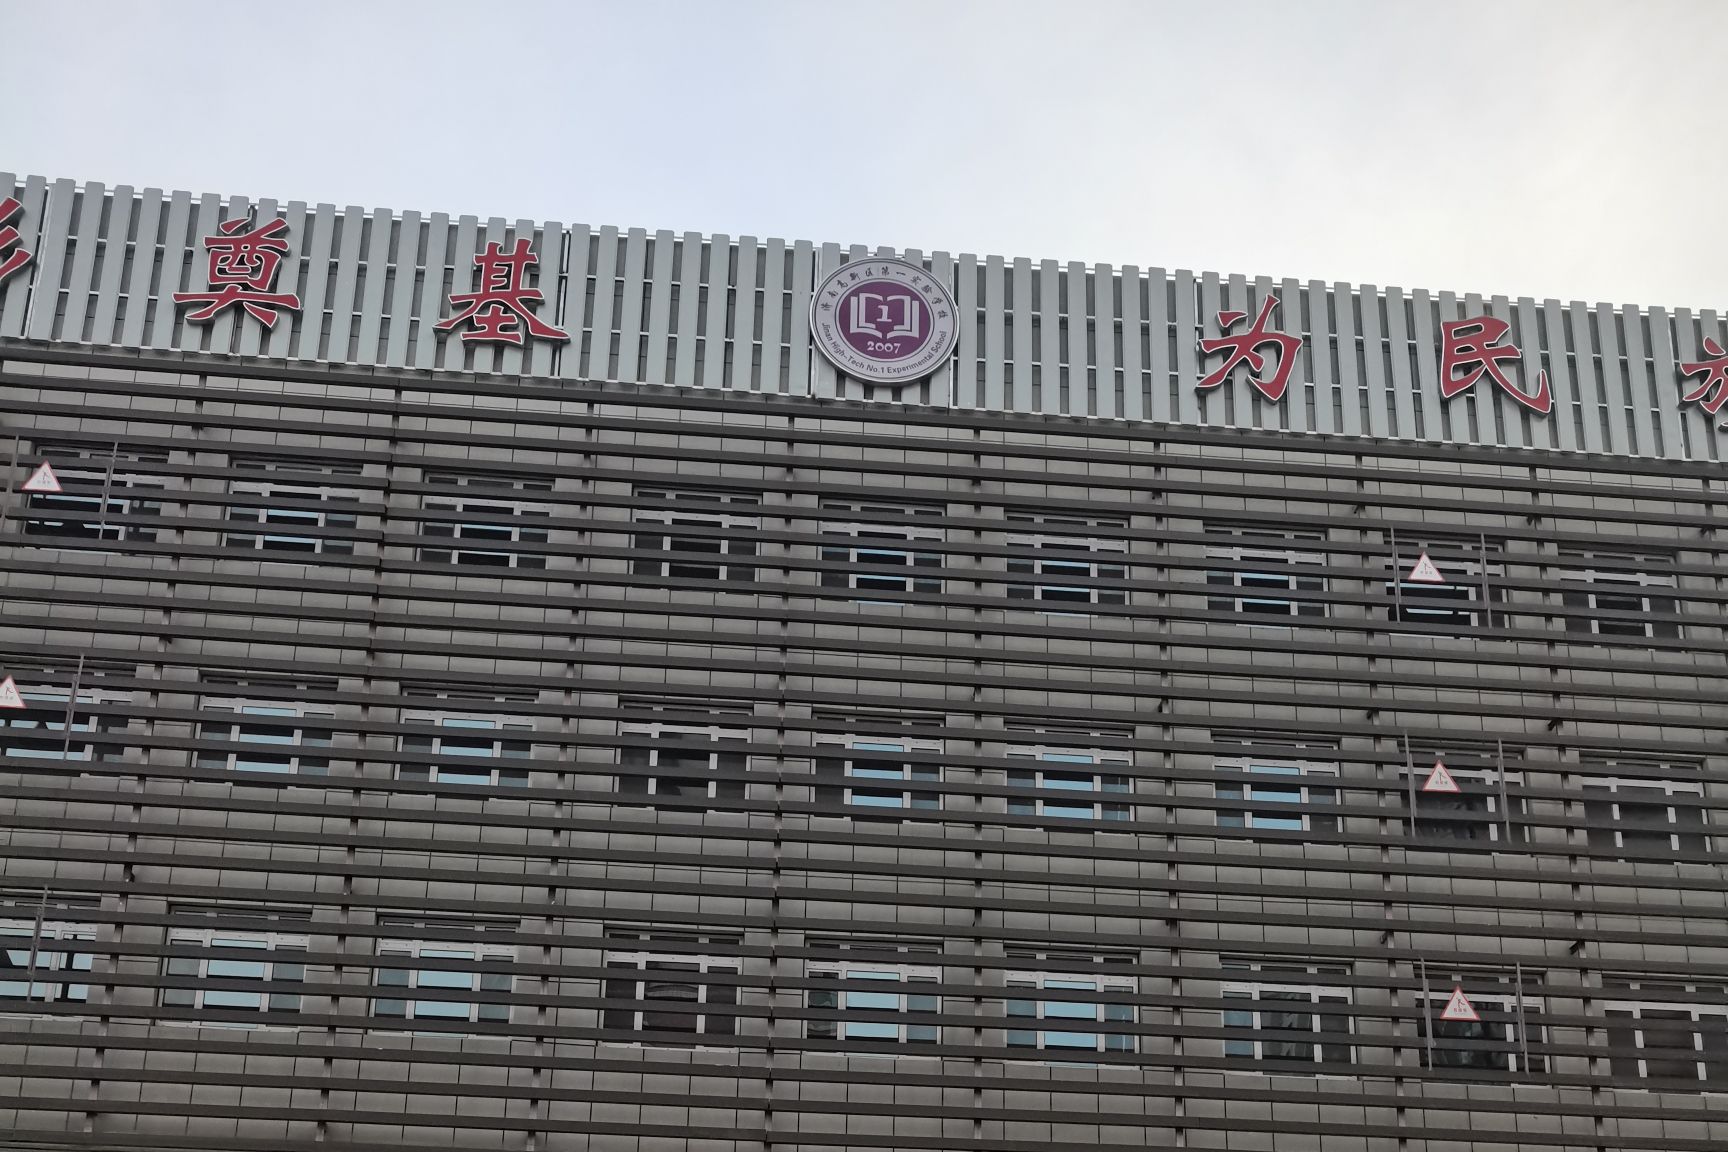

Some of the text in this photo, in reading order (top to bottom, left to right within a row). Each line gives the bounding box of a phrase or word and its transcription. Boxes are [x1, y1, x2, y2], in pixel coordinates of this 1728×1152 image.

[821, 322, 833, 342] Jinan
[887, 351, 934, 374] Experimental
[931, 331, 948, 353] School
[866, 341, 902, 354] 2007
